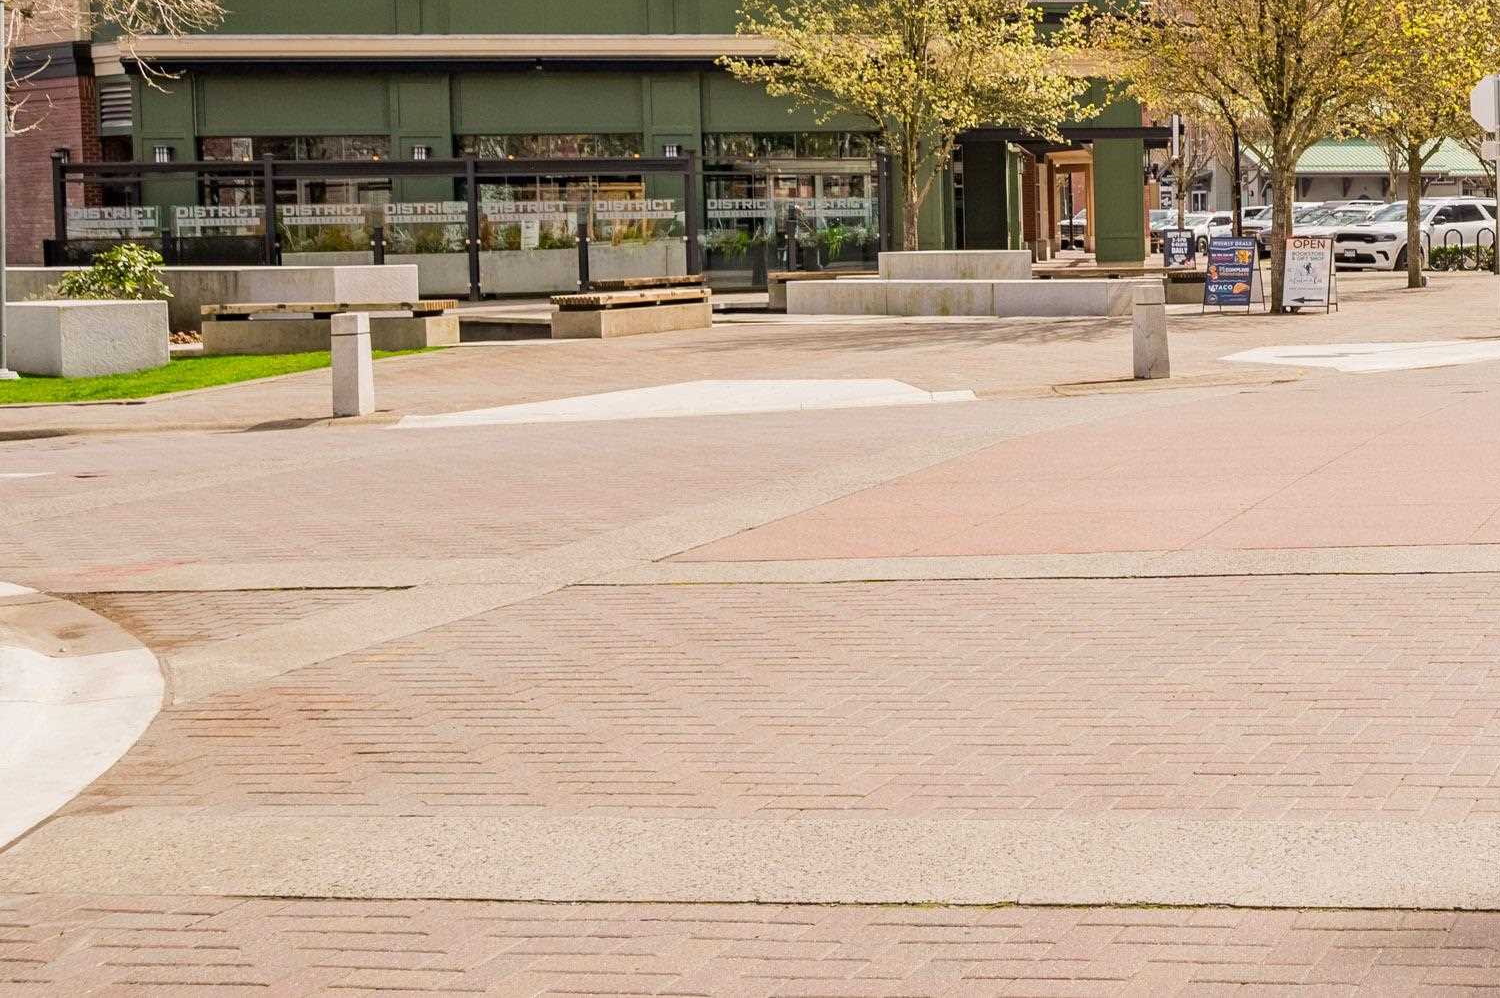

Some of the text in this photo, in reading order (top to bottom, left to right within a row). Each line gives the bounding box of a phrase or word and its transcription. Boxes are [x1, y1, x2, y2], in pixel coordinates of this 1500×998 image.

[176, 205, 258, 218] DISTRICT
[283, 203, 365, 216] DISTRICT
[596, 199, 674, 211] DISTRICT
[70, 206, 155, 219] DISTRICT
[1293, 239, 1325, 249] OPEN
